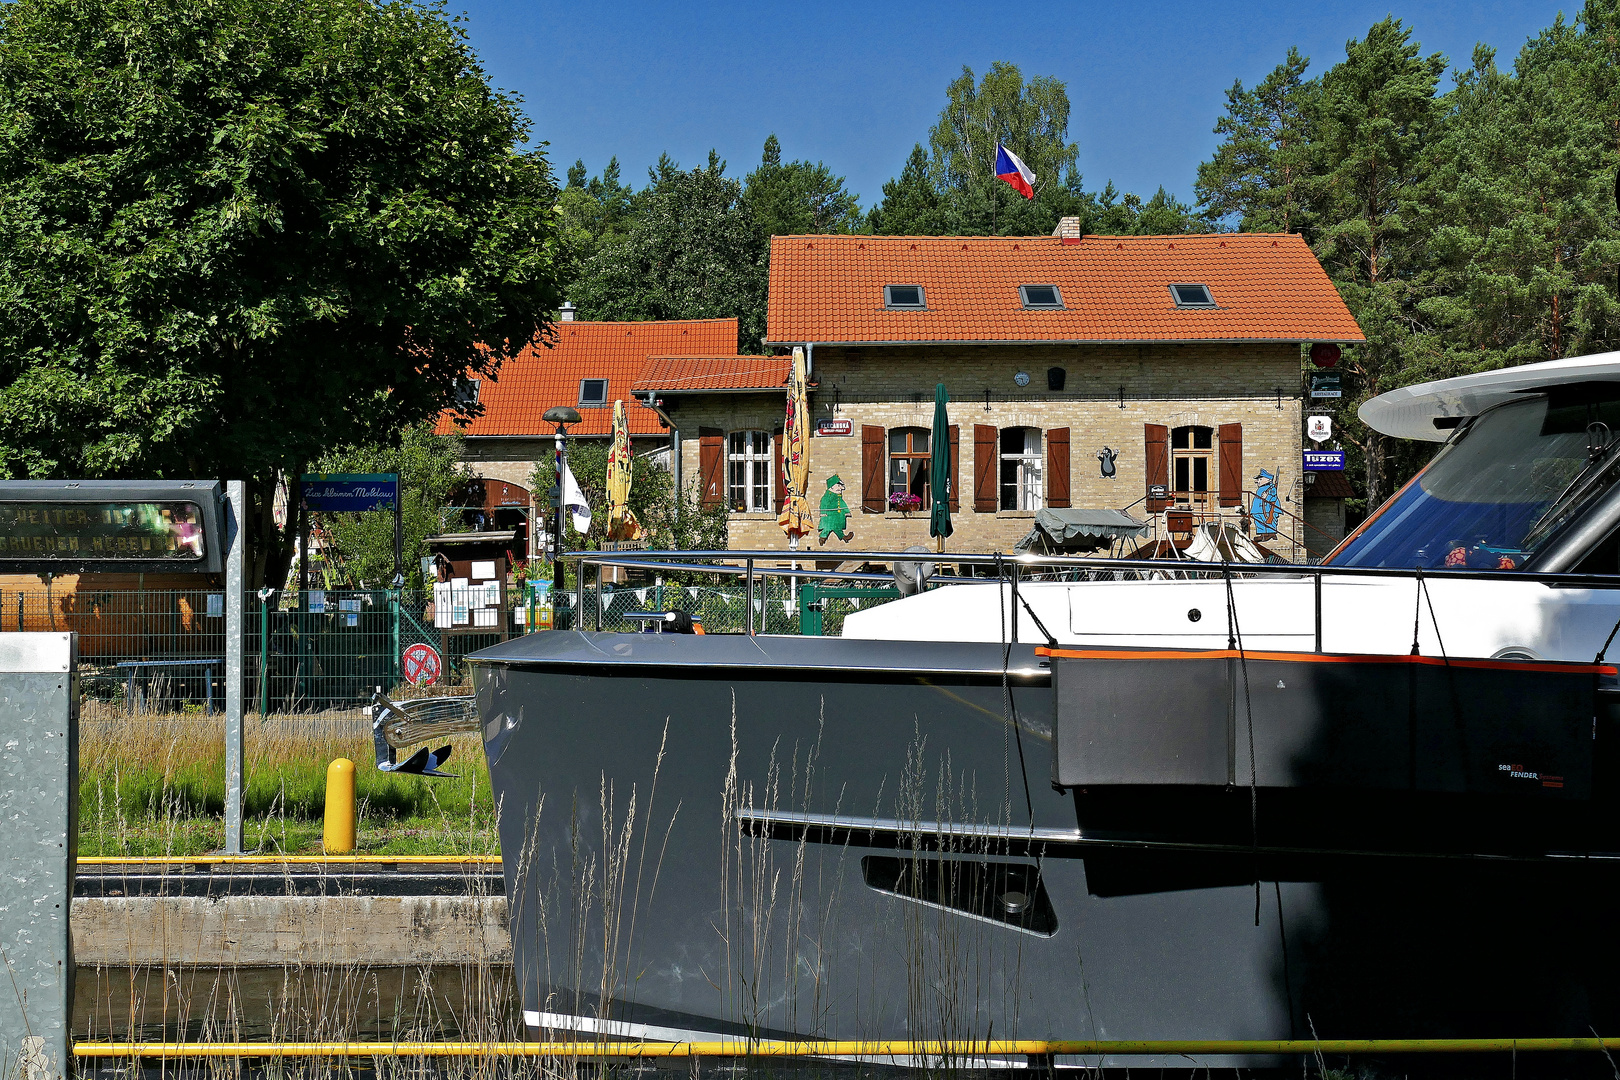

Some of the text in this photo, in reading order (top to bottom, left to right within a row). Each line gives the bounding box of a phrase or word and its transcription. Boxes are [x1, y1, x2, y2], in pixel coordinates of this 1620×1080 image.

[1304, 454, 1342, 463] Tuzex
[353, 487, 394, 498] Moldau
[709, 482, 719, 495] 1
[1510, 771, 1539, 780] FENDER
